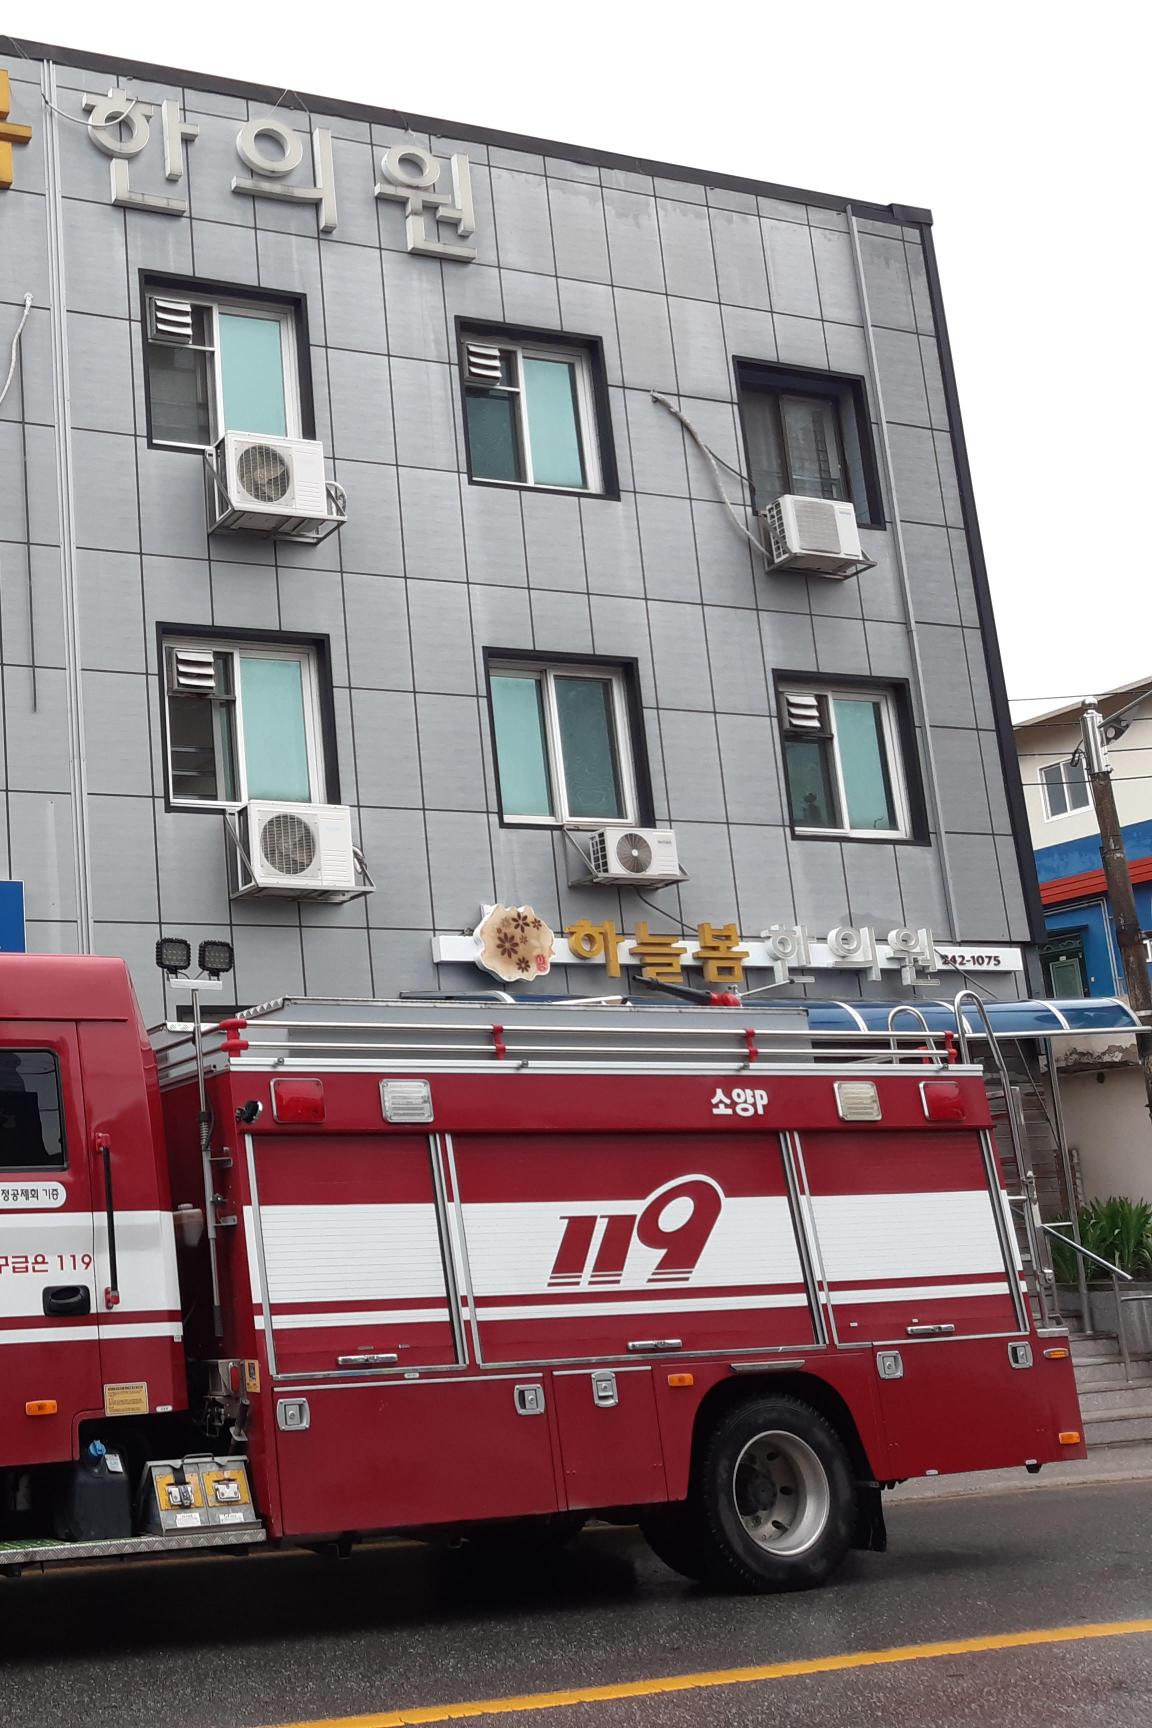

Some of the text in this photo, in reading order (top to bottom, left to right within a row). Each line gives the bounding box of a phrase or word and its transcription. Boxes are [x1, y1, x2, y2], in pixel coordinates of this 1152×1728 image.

[82, 87, 477, 263] 한의원
[563, 919, 1002, 986] 하늘봄 한의원 242-1075
[710, 1088, 769, 1117] 소양P
[42, 1187, 59, 1201] 기증
[547, 1178, 724, 1287] 119
[57, 1253, 93, 1271] 119
